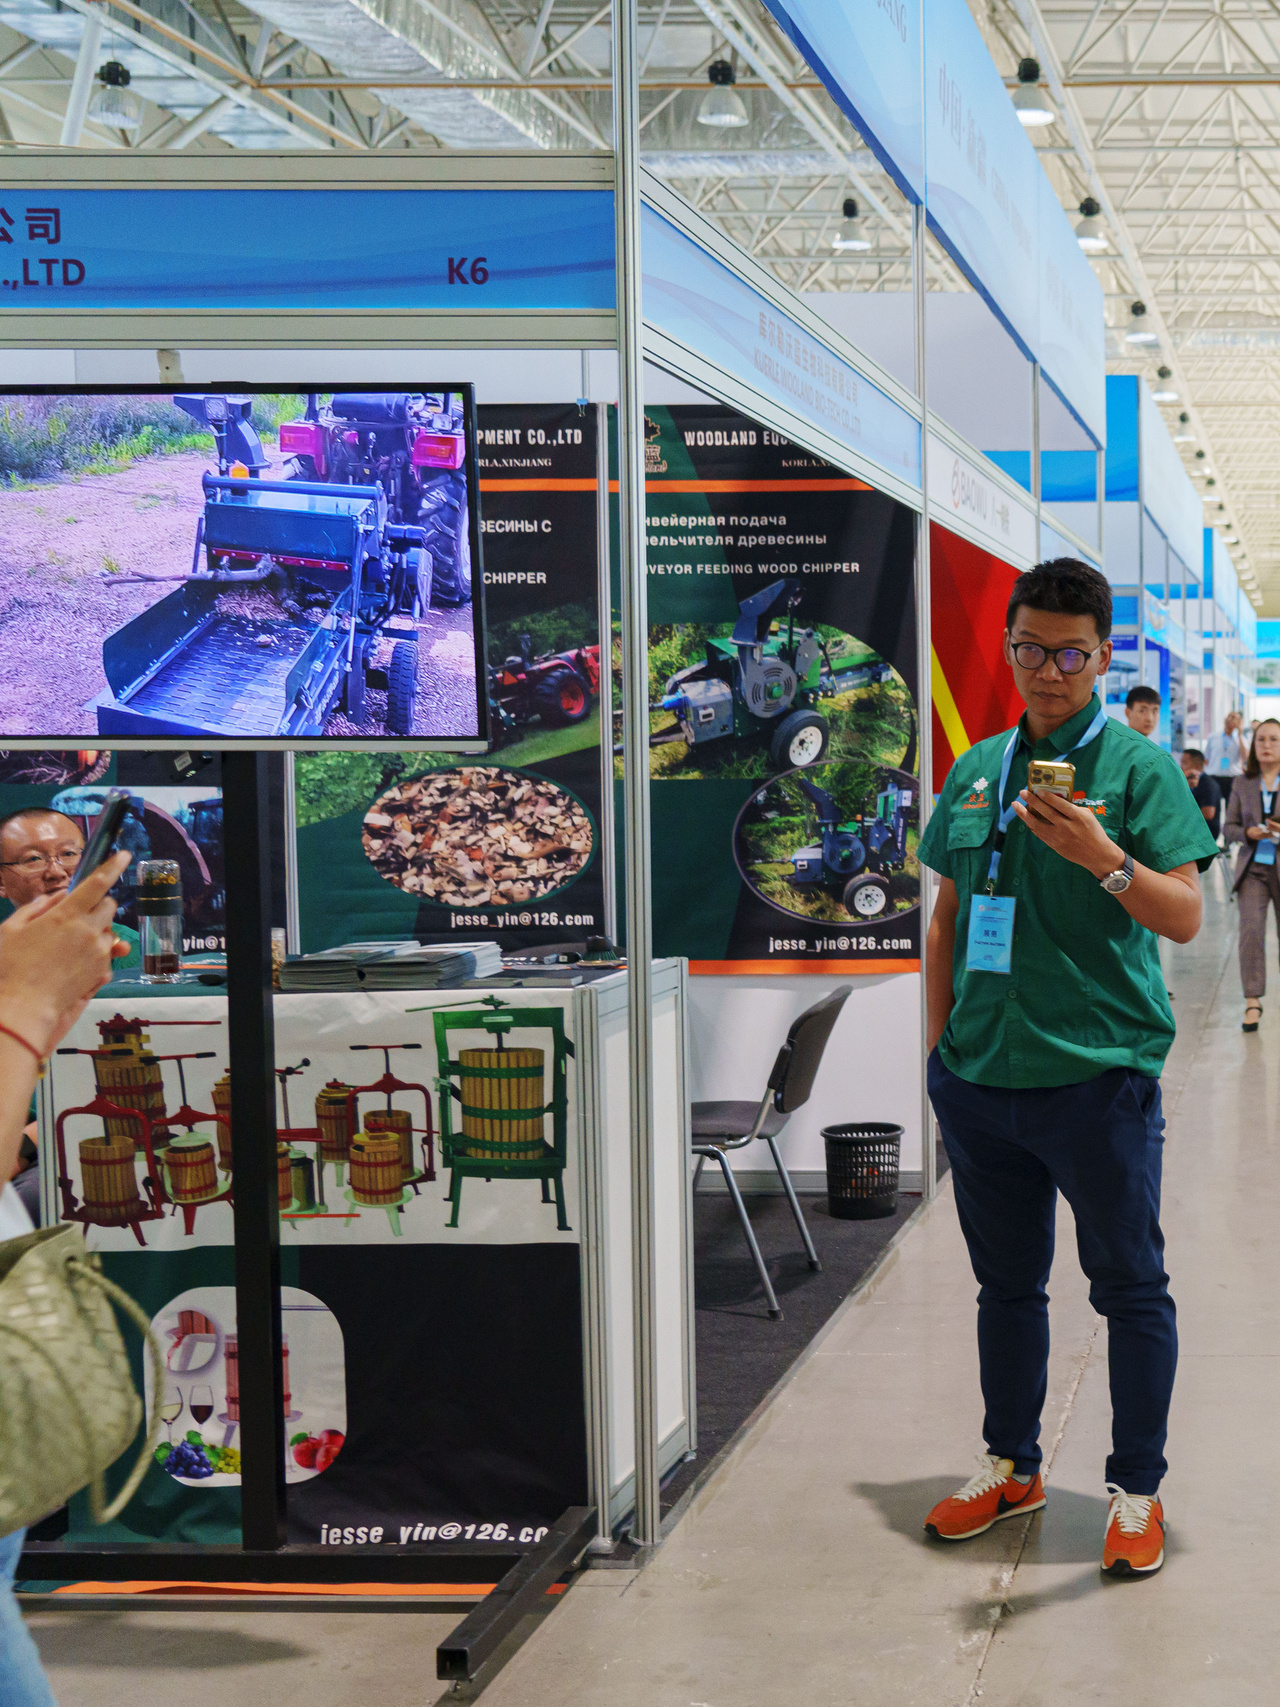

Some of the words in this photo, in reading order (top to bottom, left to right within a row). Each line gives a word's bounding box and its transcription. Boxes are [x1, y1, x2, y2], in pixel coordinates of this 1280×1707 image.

[447, 257, 489, 286] K6
[477, 429, 521, 445] PMENT
[527, 428, 583, 447] CO.,LTD
[684, 431, 757, 447] WOODLAND
[763, 431, 793, 447] EQU
[729, 515, 787, 528] подача
[737, 534, 828, 549] древесины
[696, 563, 754, 575] FEEDING
[758, 563, 799, 574] WOOD
[802, 562, 861, 574] CHIPPER
[482, 572, 547, 585] CHIPPER
[450, 911, 594, 929] jesse_yin@126.com
[768, 936, 912, 953] jesse_yin@126.com
